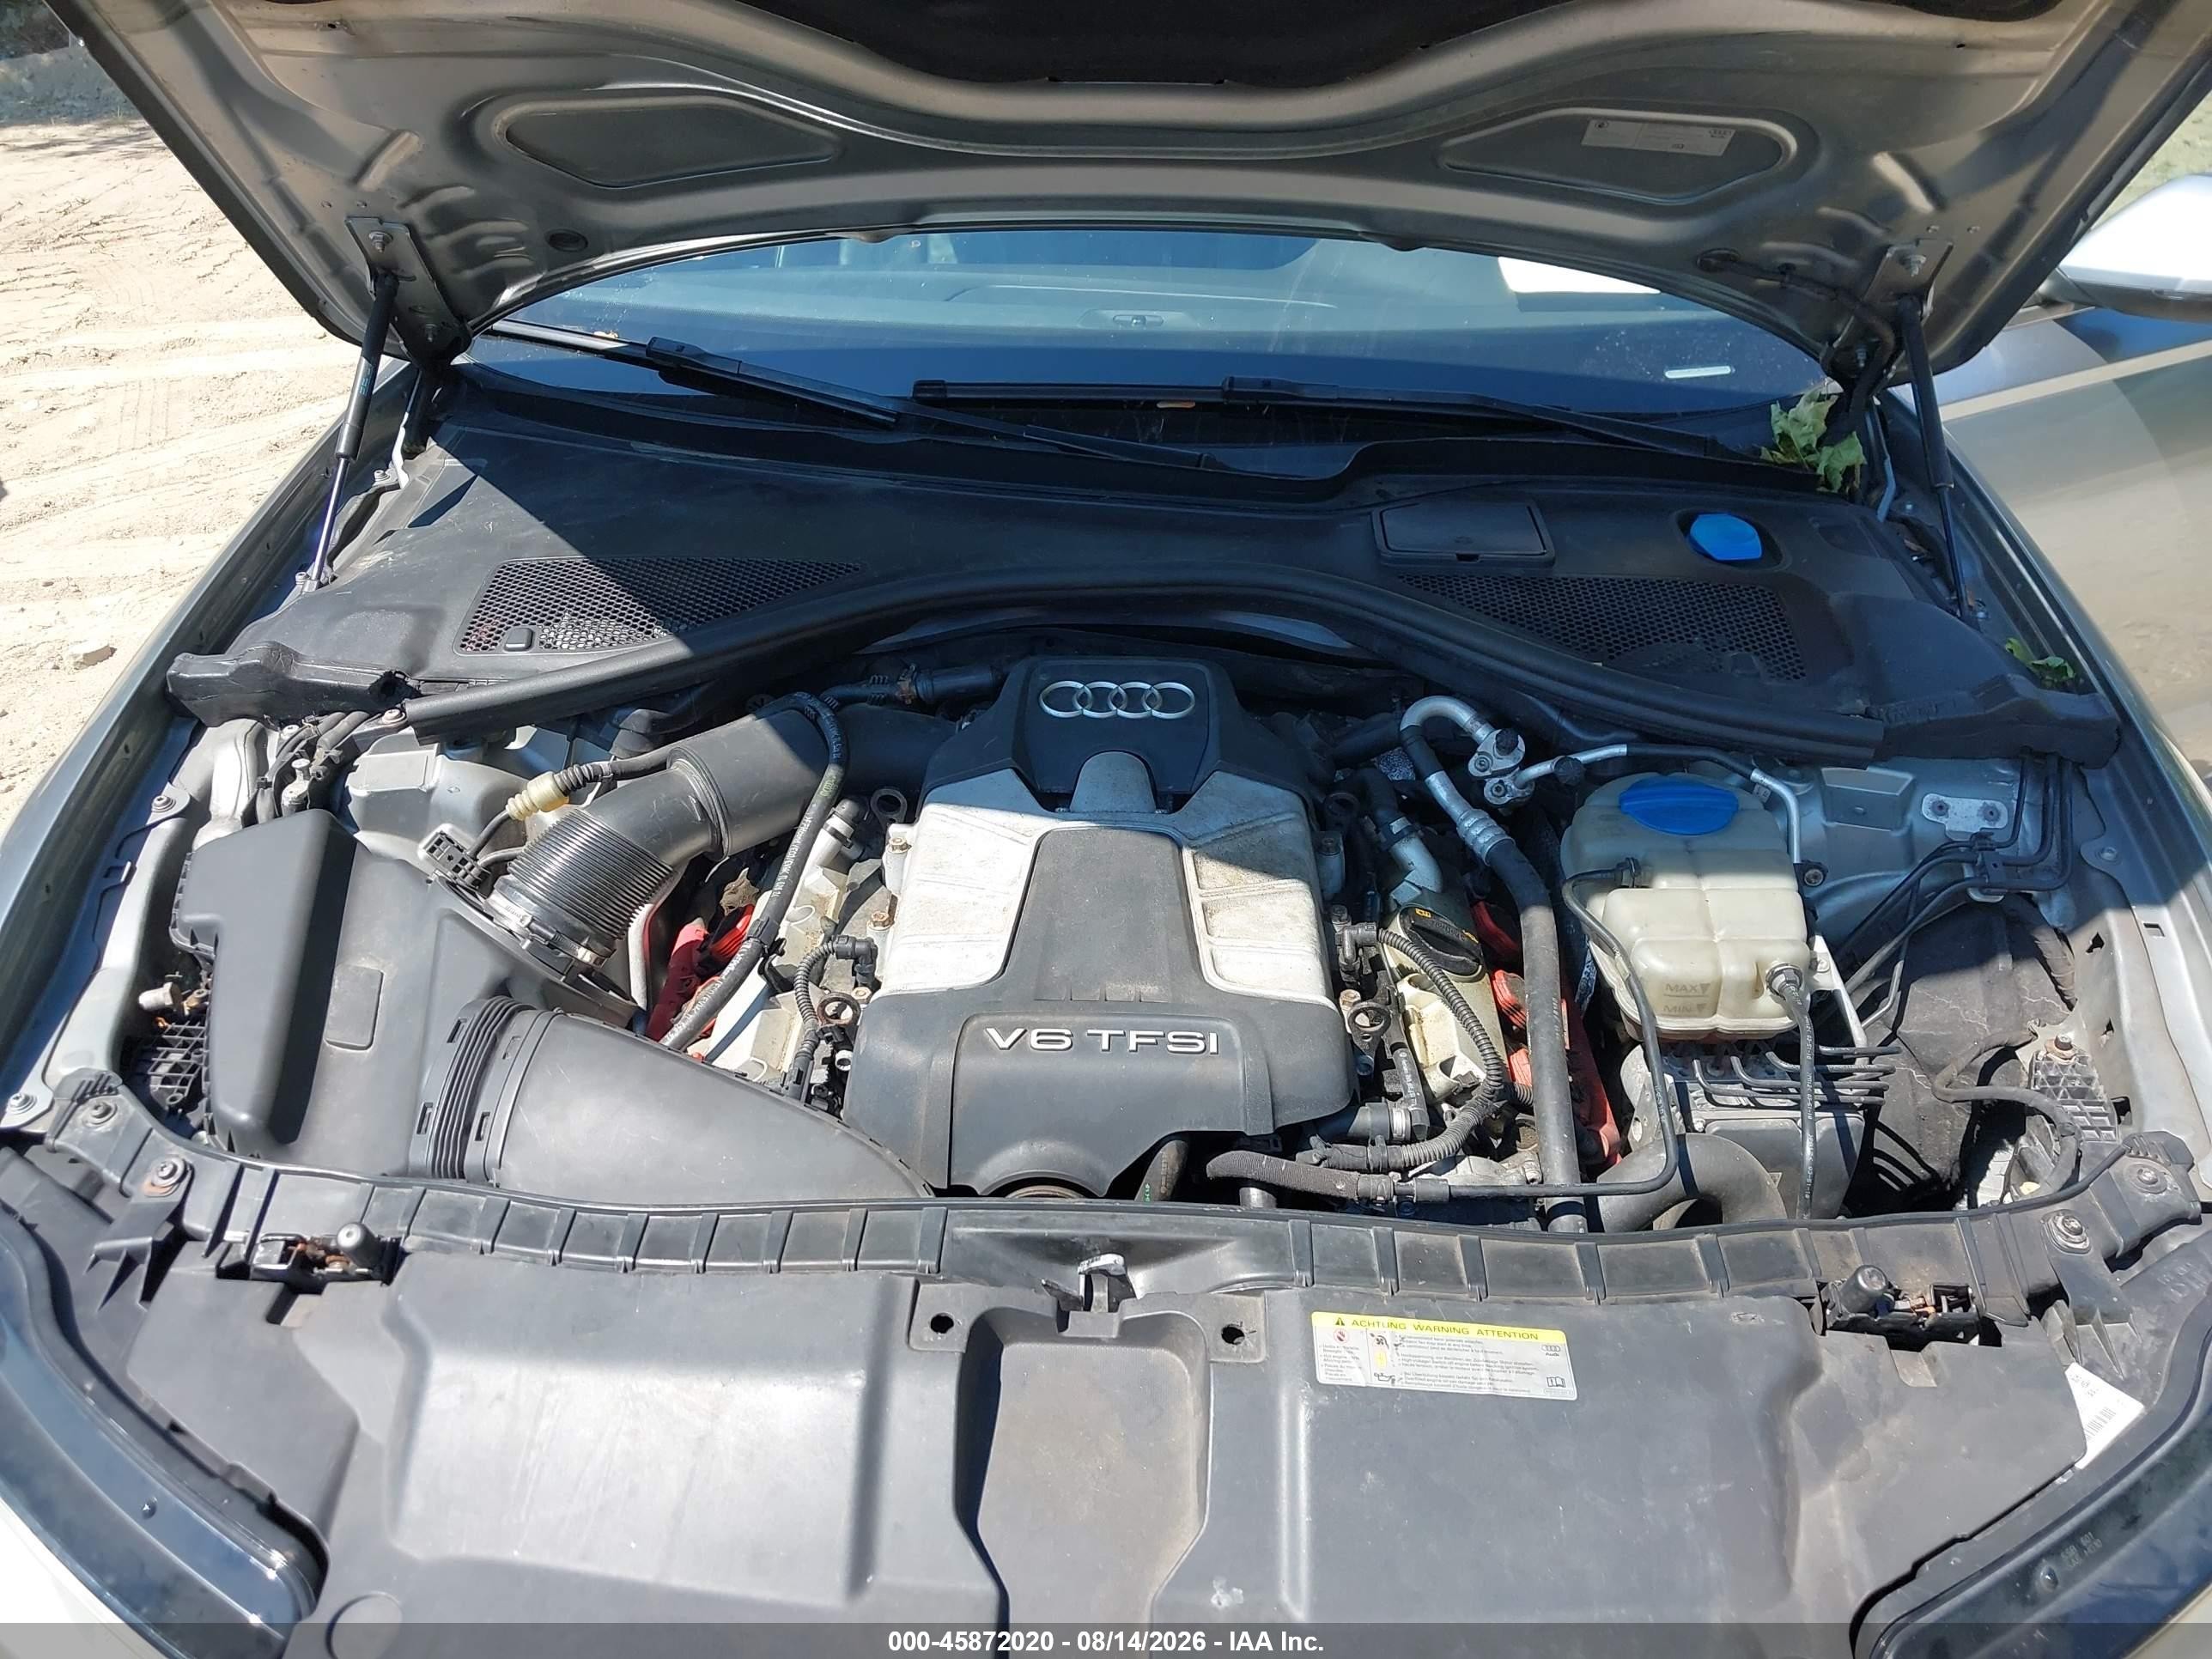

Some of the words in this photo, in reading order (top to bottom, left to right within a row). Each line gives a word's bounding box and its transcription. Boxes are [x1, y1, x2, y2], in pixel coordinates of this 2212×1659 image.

[1665, 983, 1698, 994] MAX
[1663, 1005, 1692, 1013] MIN
[985, 1027, 1073, 1051] V6
[1086, 1029, 1218, 1054] TFSI
[1352, 1319, 1407, 1330] ACHTUNG
[1413, 1323, 1470, 1335] WARNING
[1476, 1328, 1539, 1340] ATTENTION
